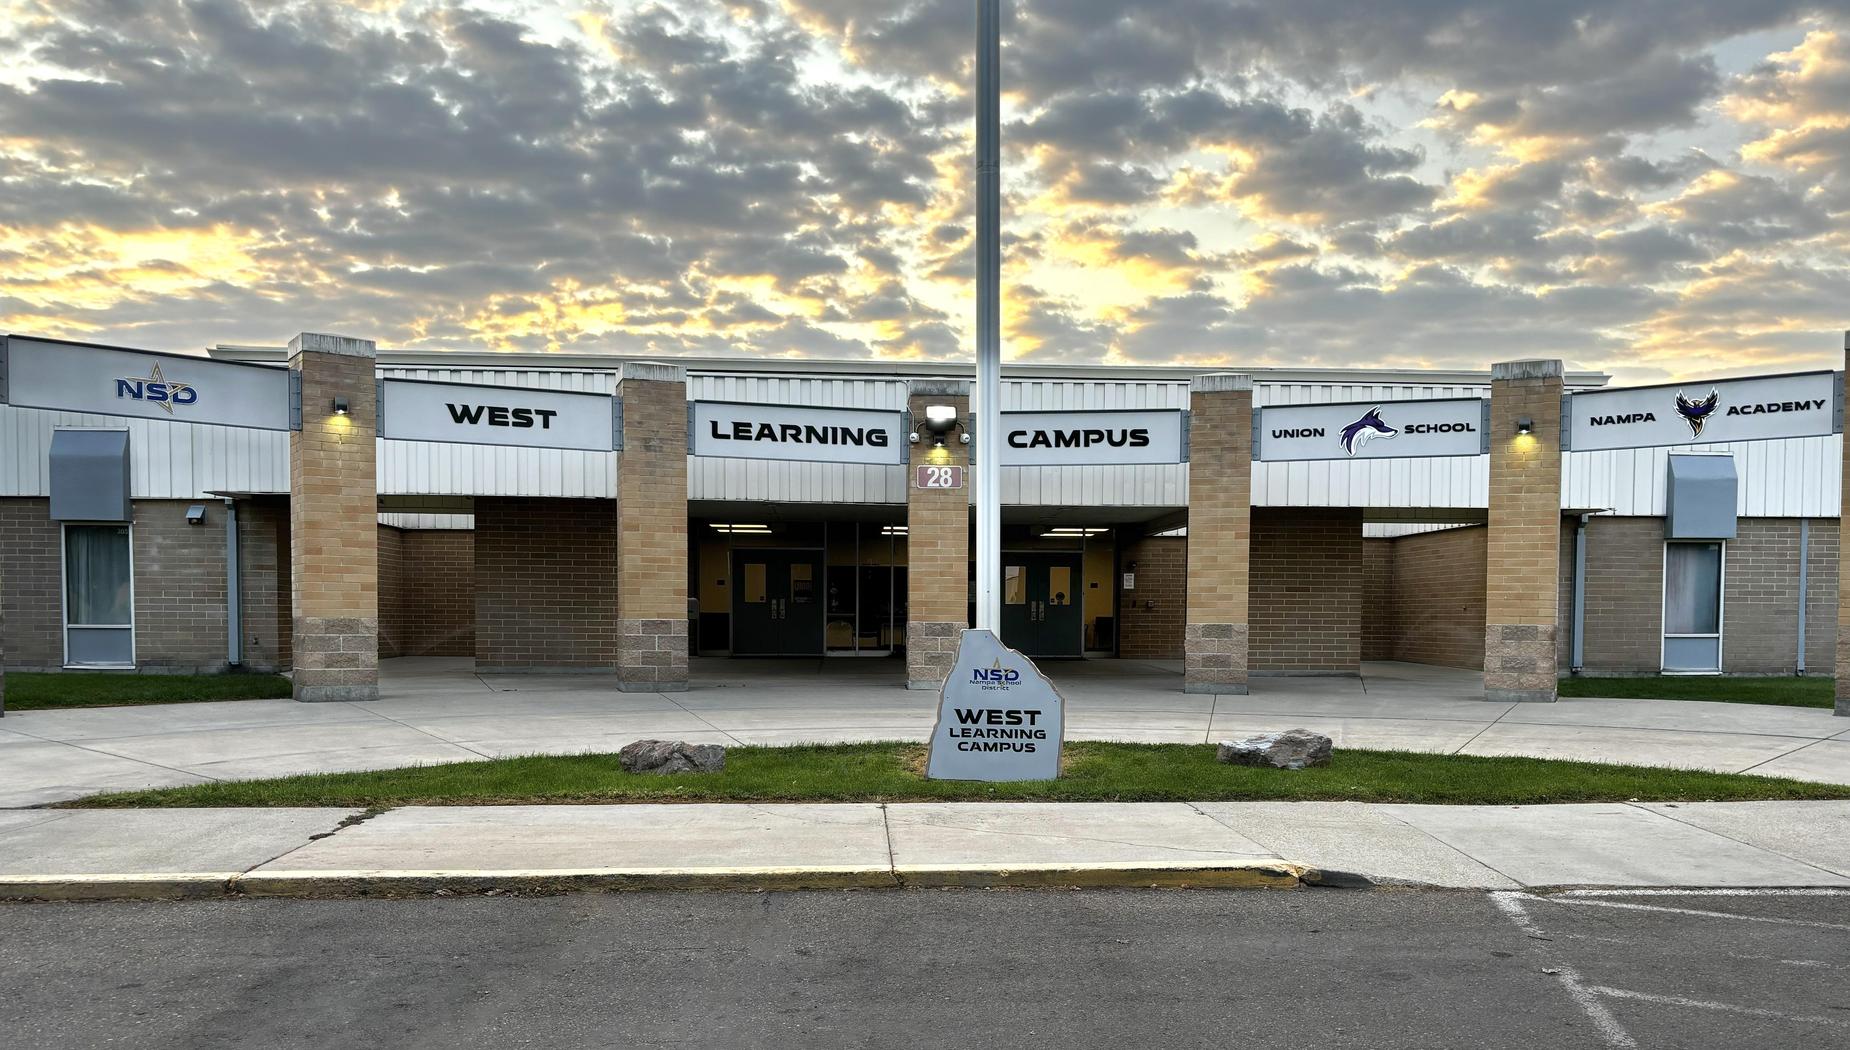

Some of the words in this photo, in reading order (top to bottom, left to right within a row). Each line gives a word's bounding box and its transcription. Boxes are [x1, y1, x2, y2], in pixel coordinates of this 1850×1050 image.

[114, 378, 197, 404] NSD
[445, 403, 558, 429] WEST
[1590, 412, 1656, 426] NAMPA
[1726, 399, 1826, 416] ACADEMY
[709, 420, 888, 447] LEARNING
[1008, 429, 1150, 448] CAMPUS
[1271, 428, 1325, 438] UNION
[1404, 423, 1476, 434] SCHOOL
[927, 467, 953, 488] 28
[973, 668, 1020, 681] NSD
[954, 708, 1042, 726] WEST
[949, 727, 1047, 740] LEARNING
[957, 741, 1036, 753] CAMPUS
